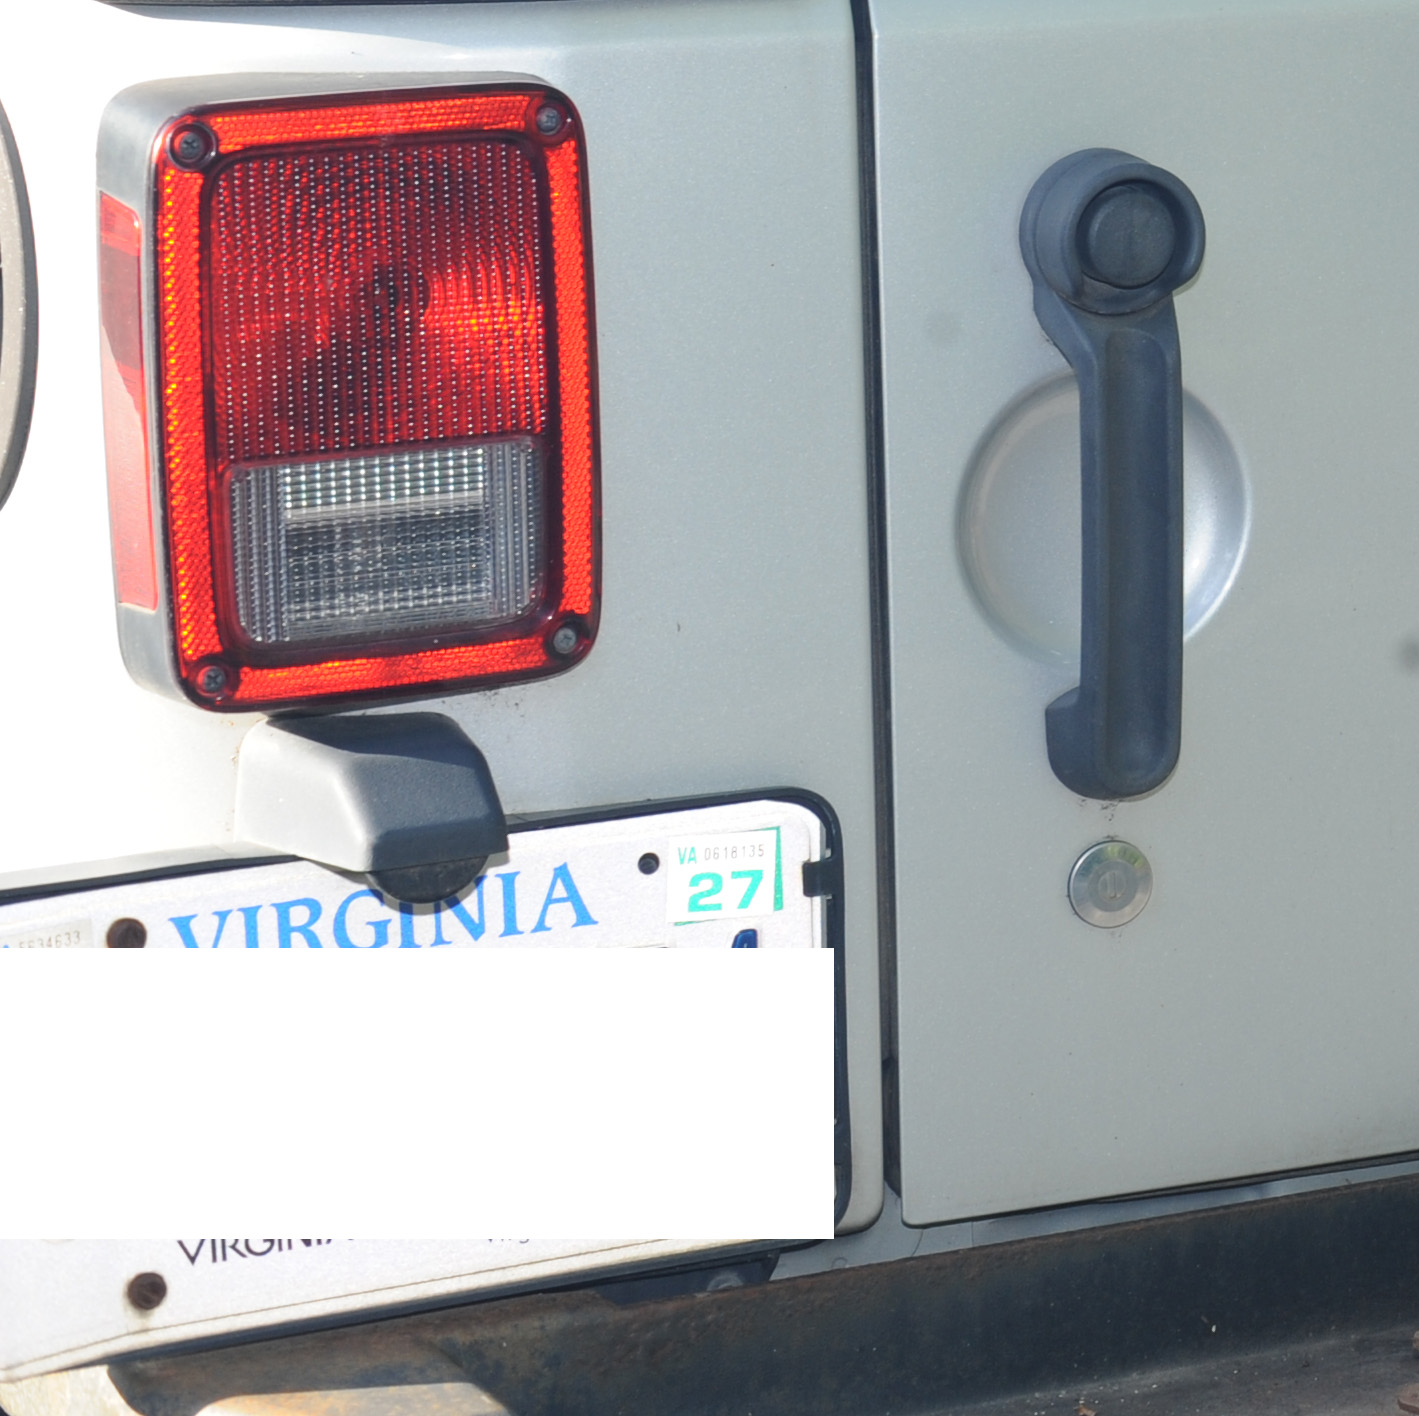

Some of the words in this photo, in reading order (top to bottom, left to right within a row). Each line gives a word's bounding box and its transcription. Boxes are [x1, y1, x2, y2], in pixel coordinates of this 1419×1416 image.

[677, 846, 697, 865] VA
[704, 844, 765, 861] 0618135
[687, 869, 764, 912] 27
